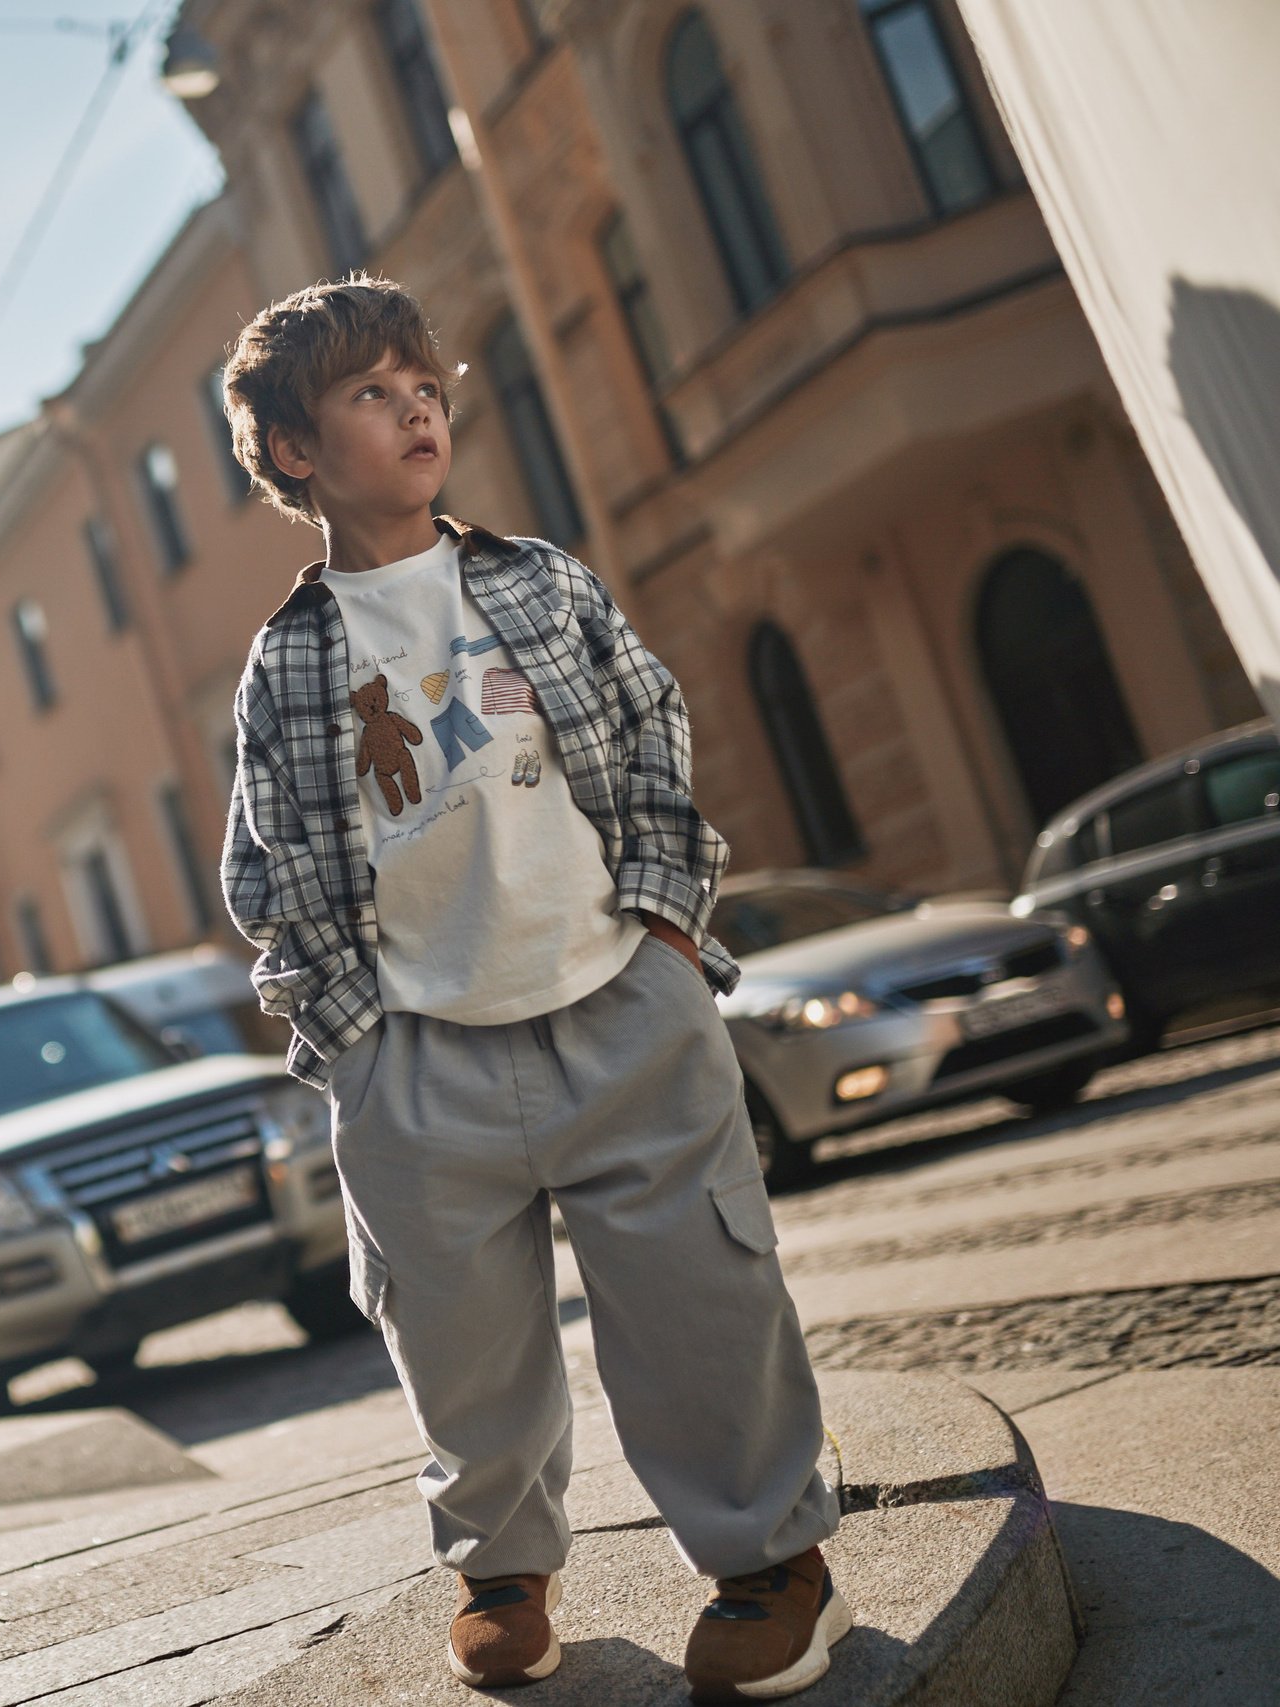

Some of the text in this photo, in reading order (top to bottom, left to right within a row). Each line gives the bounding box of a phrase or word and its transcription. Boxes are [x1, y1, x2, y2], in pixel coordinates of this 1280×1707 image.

[349, 646, 408, 674] best friend
[382, 829, 405, 844] make
[445, 794, 469, 812] look
